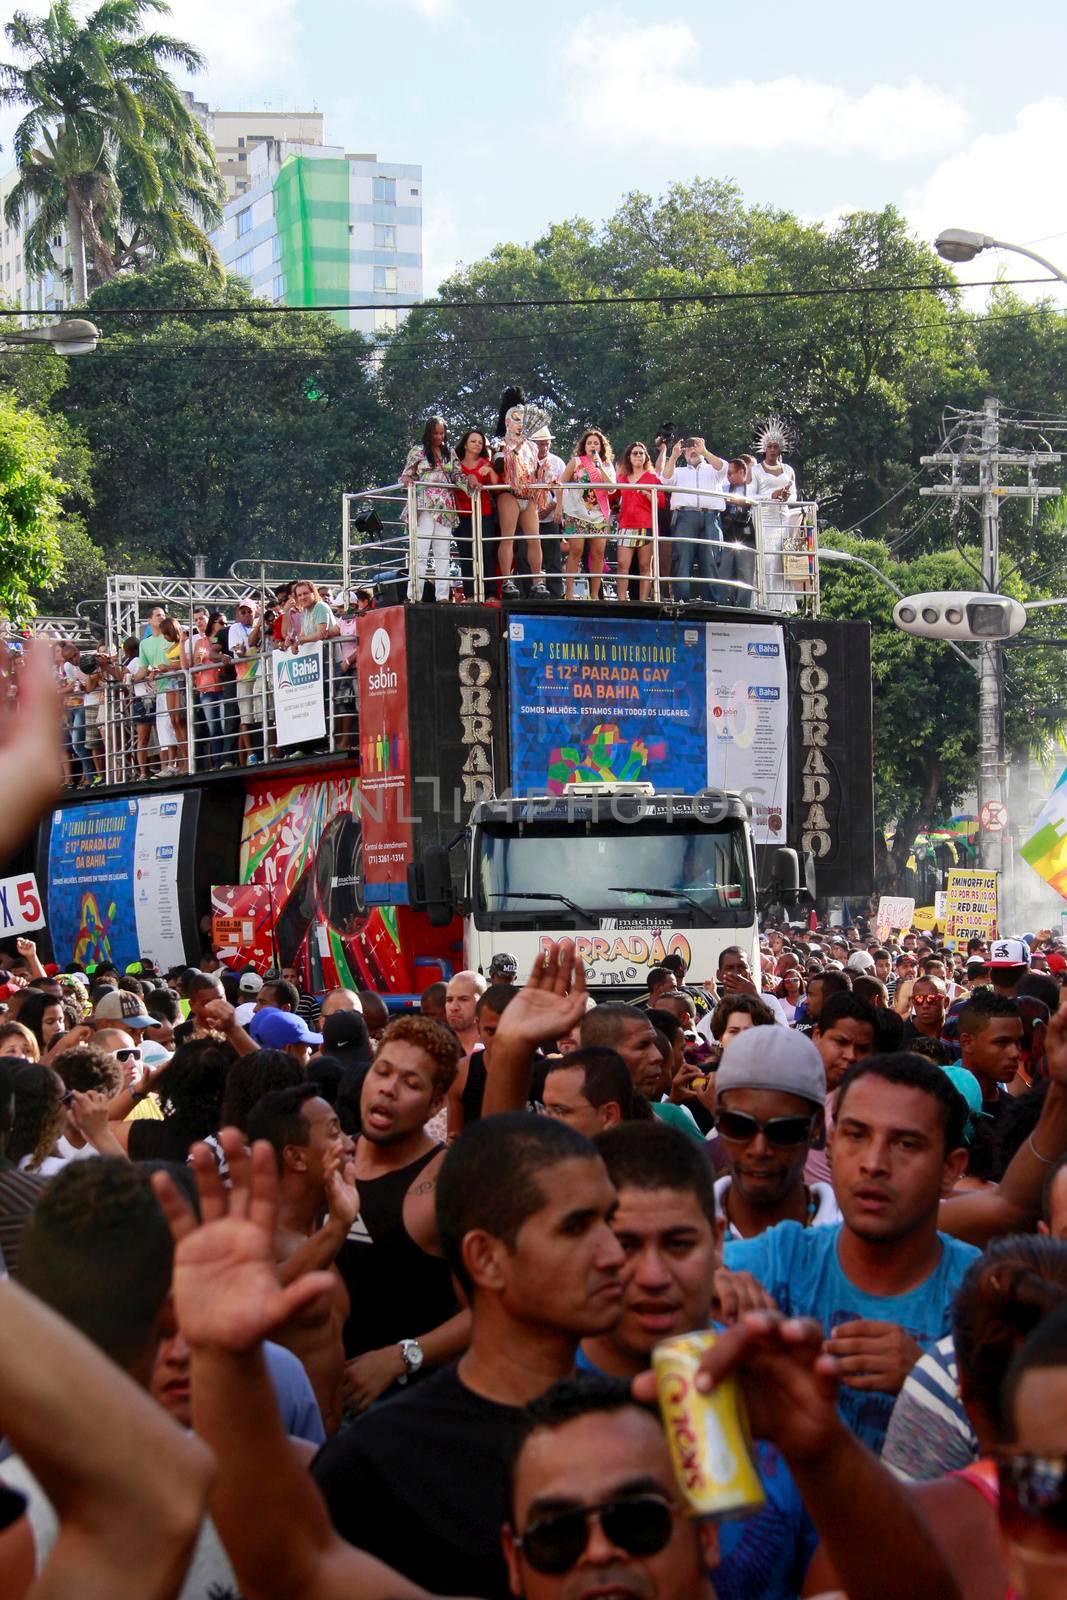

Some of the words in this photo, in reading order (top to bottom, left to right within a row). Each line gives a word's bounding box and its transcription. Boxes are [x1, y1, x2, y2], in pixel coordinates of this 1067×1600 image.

[549, 643, 589, 661] SEMANA
[594, 645, 606, 662] DA
[612, 645, 677, 664] DIVERSIDADE
[758, 645, 778, 653] Bahia
[293, 658, 318, 678] Bahia
[546, 666, 554, 680] E
[582, 666, 640, 682] PARADA
[643, 668, 670, 682] GAY
[368, 666, 397, 690] sabin
[573, 684, 592, 698] DA
[596, 684, 640, 700] BAHIA
[758, 688, 778, 696] Bahia
[520, 705, 546, 714] SOMOS
[546, 705, 579, 715] MILHÕES.
[580, 706, 612, 716] ESTAMOS
[613, 707, 624, 716] EM
[625, 707, 646, 716] TODOS
[648, 708, 657, 716] OS
[658, 708, 690, 718] LUGARES.
[984, 880, 995, 888] ICE
[16, 880, 41, 922] 5
[957, 902, 970, 912] RED
[972, 904, 988, 913] BULL
[619, 918, 673, 926] machine
[956, 928, 986, 939] CERVEJA
[600, 966, 637, 984] TRIO
